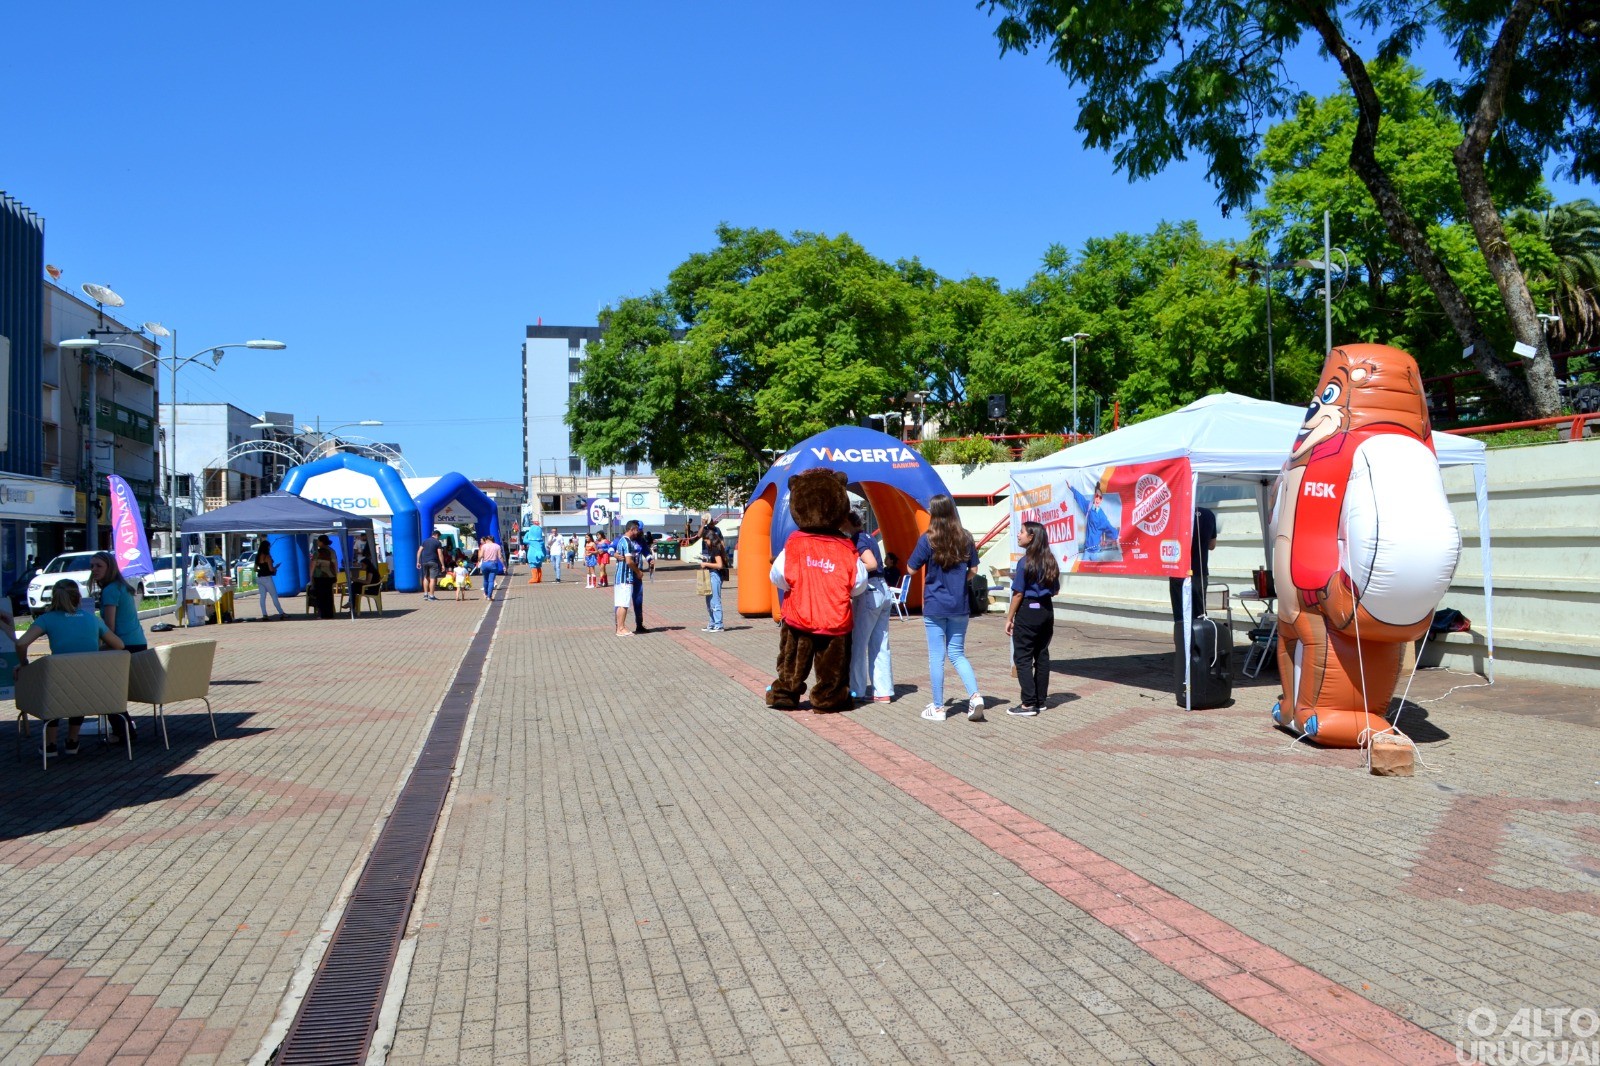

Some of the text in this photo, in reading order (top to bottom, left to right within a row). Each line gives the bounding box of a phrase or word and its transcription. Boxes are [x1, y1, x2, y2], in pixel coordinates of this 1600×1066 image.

[811, 447, 916, 463] VIACERTA
[1304, 481, 1336, 499] FISK
[312, 498, 377, 509] ARSOL
[117, 484, 134, 545] AFINATO
[437, 514, 456, 522] Senac
[1042, 509, 1060, 521] PRONTAS
